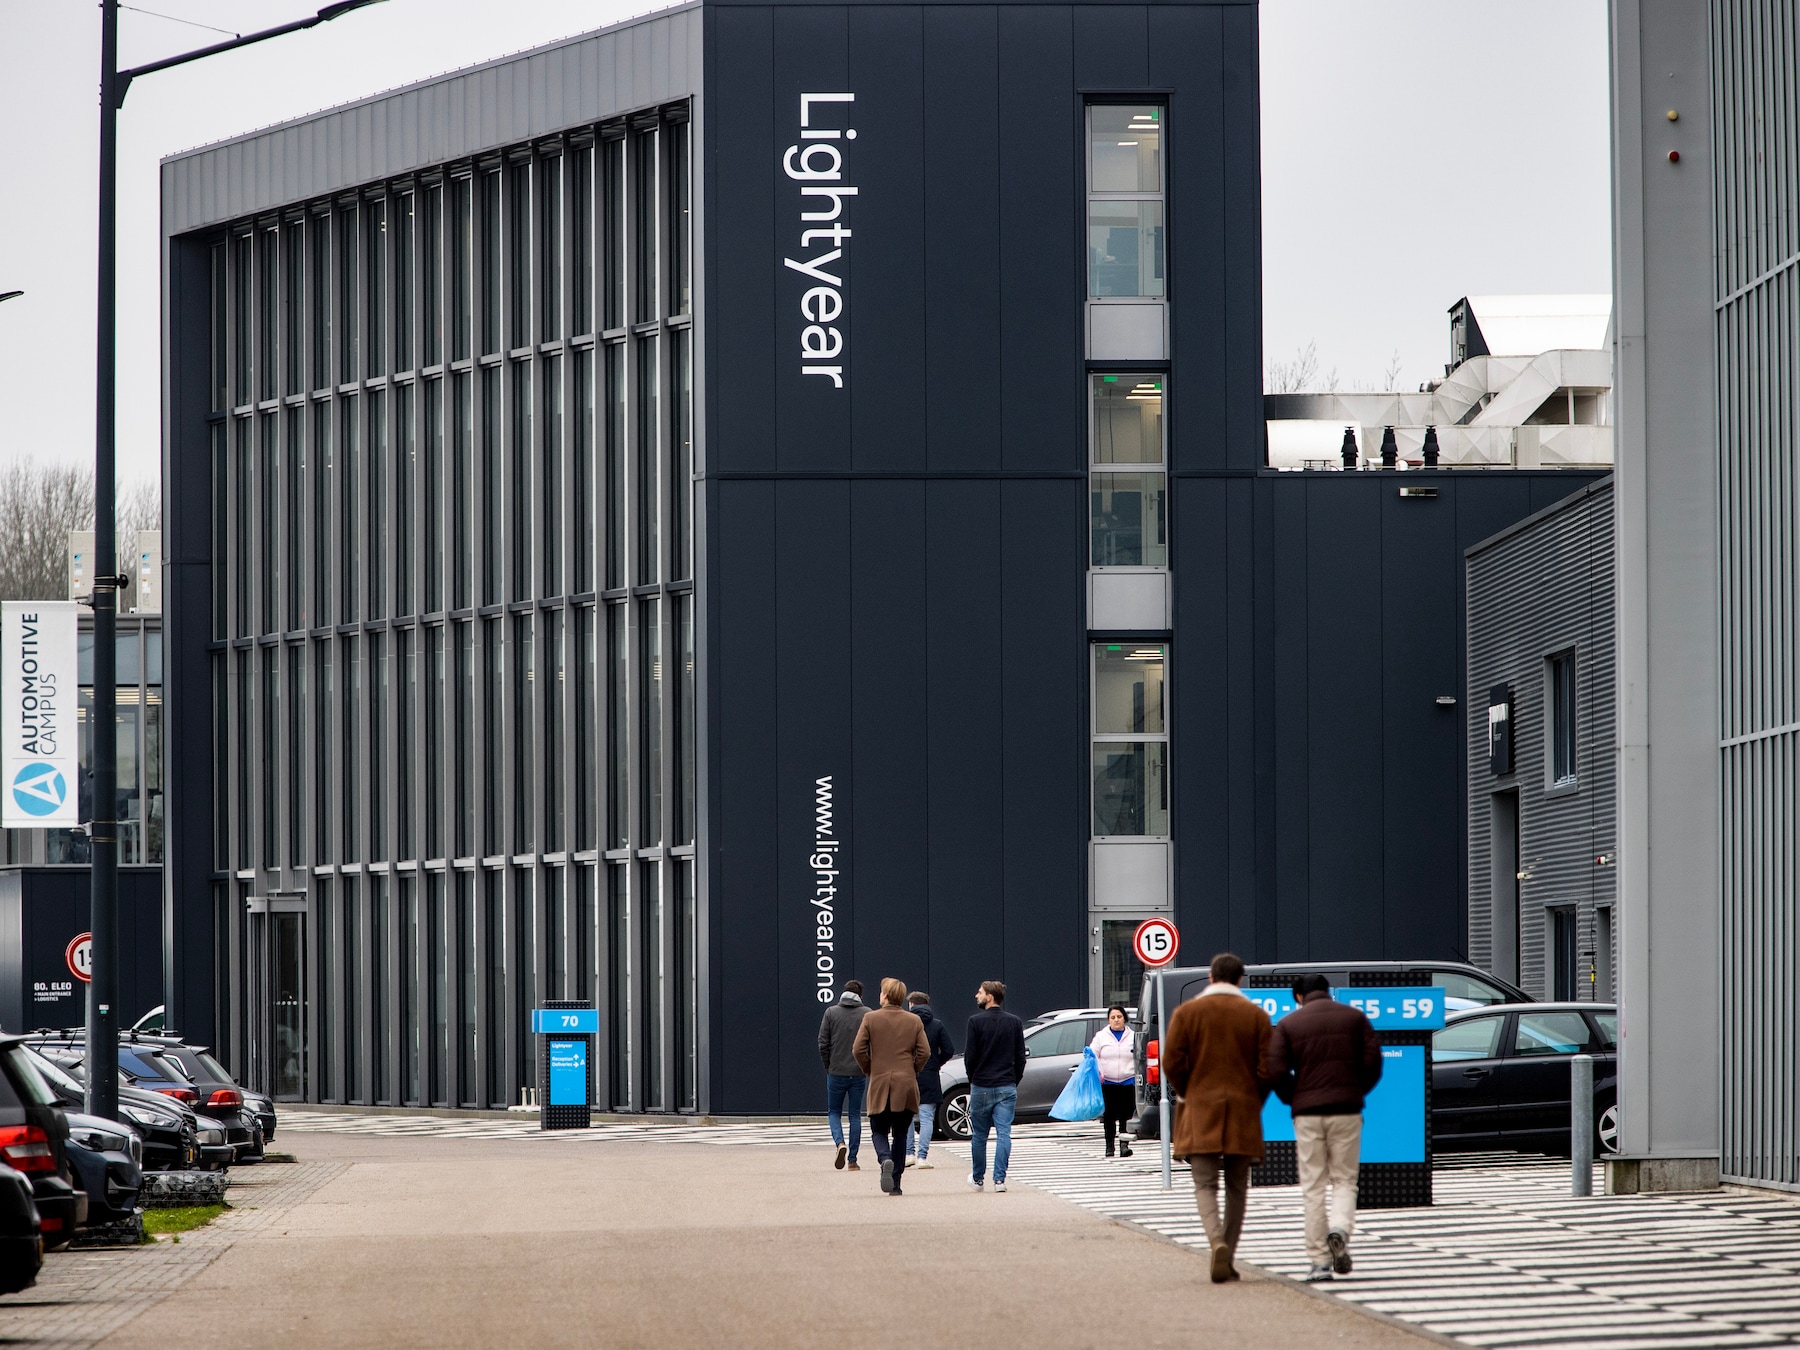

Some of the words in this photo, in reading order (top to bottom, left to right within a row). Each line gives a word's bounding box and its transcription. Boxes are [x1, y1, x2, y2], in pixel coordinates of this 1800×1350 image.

[783, 93, 858, 388] Lightyear
[22, 613, 38, 754] AUTOMOTIVE
[40, 673, 56, 755] CAMPUS
[809, 775, 839, 1003] www.lightyear.one
[1145, 933, 1167, 951] 15
[78, 949, 92, 967] 1
[34, 982, 48, 991] 80.
[51, 982, 72, 990] ELEO
[1402, 998, 1433, 1018] 59
[561, 1015, 578, 1026] 70
